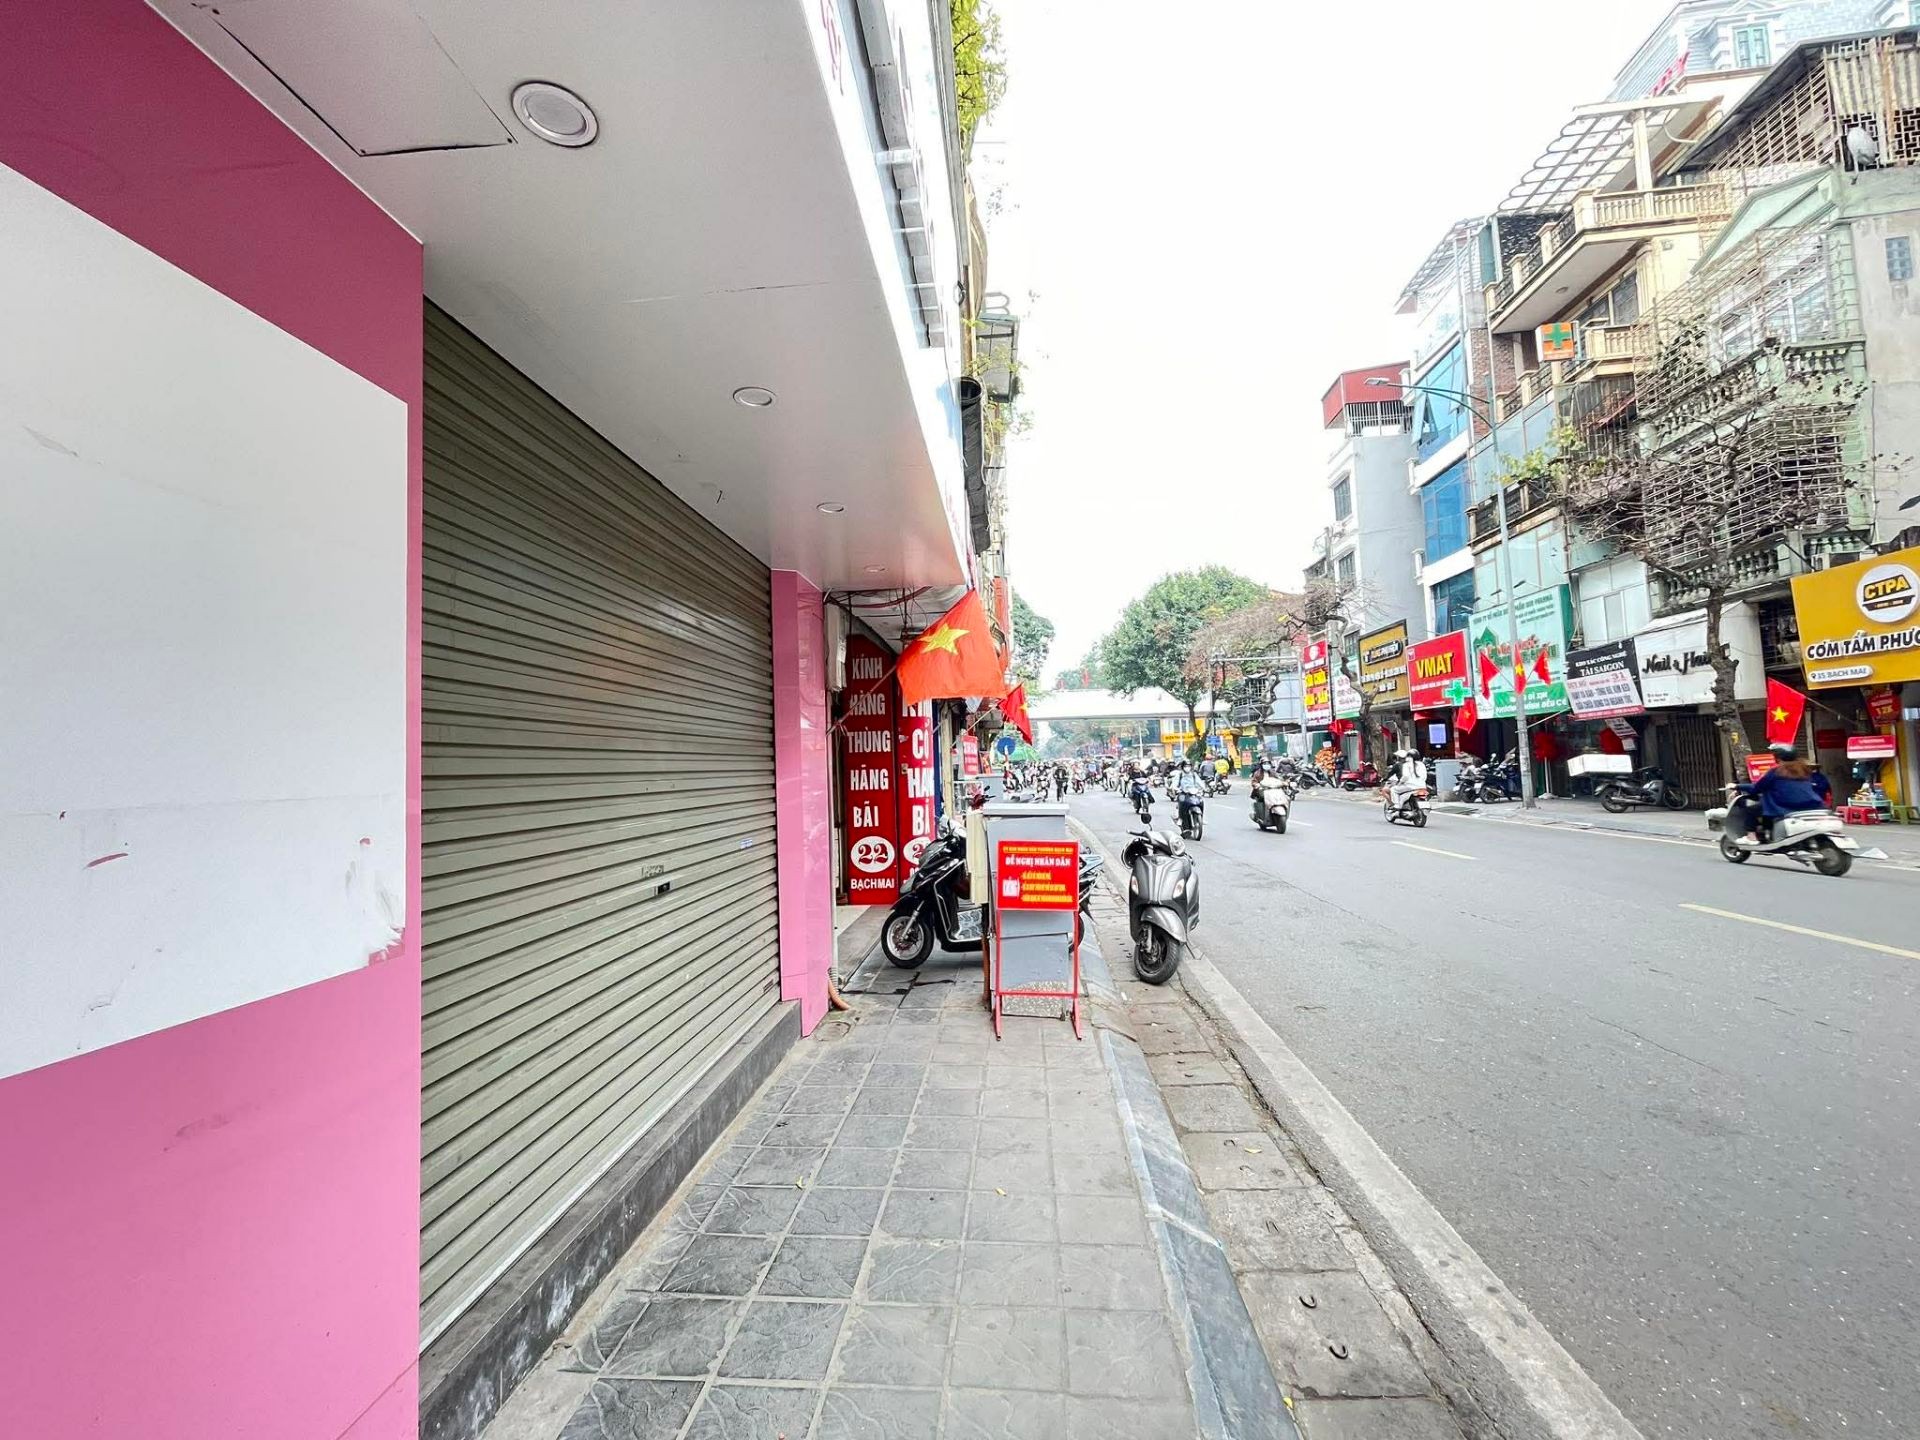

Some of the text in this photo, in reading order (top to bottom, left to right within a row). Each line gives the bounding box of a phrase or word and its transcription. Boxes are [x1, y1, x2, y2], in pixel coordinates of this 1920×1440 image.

[1864, 576, 1909, 599] CTPA
[1807, 640, 1839, 659] CƠM
[1843, 630, 1876, 653] TẤM
[852, 653, 883, 680] KÍNH
[1415, 651, 1454, 679] VMAT
[1594, 660, 1625, 674] SAIGON
[1641, 653, 1672, 674] Nail
[847, 725, 892, 754] THÙNG
[853, 800, 880, 828] BÃI
[858, 843, 889, 865] 22
